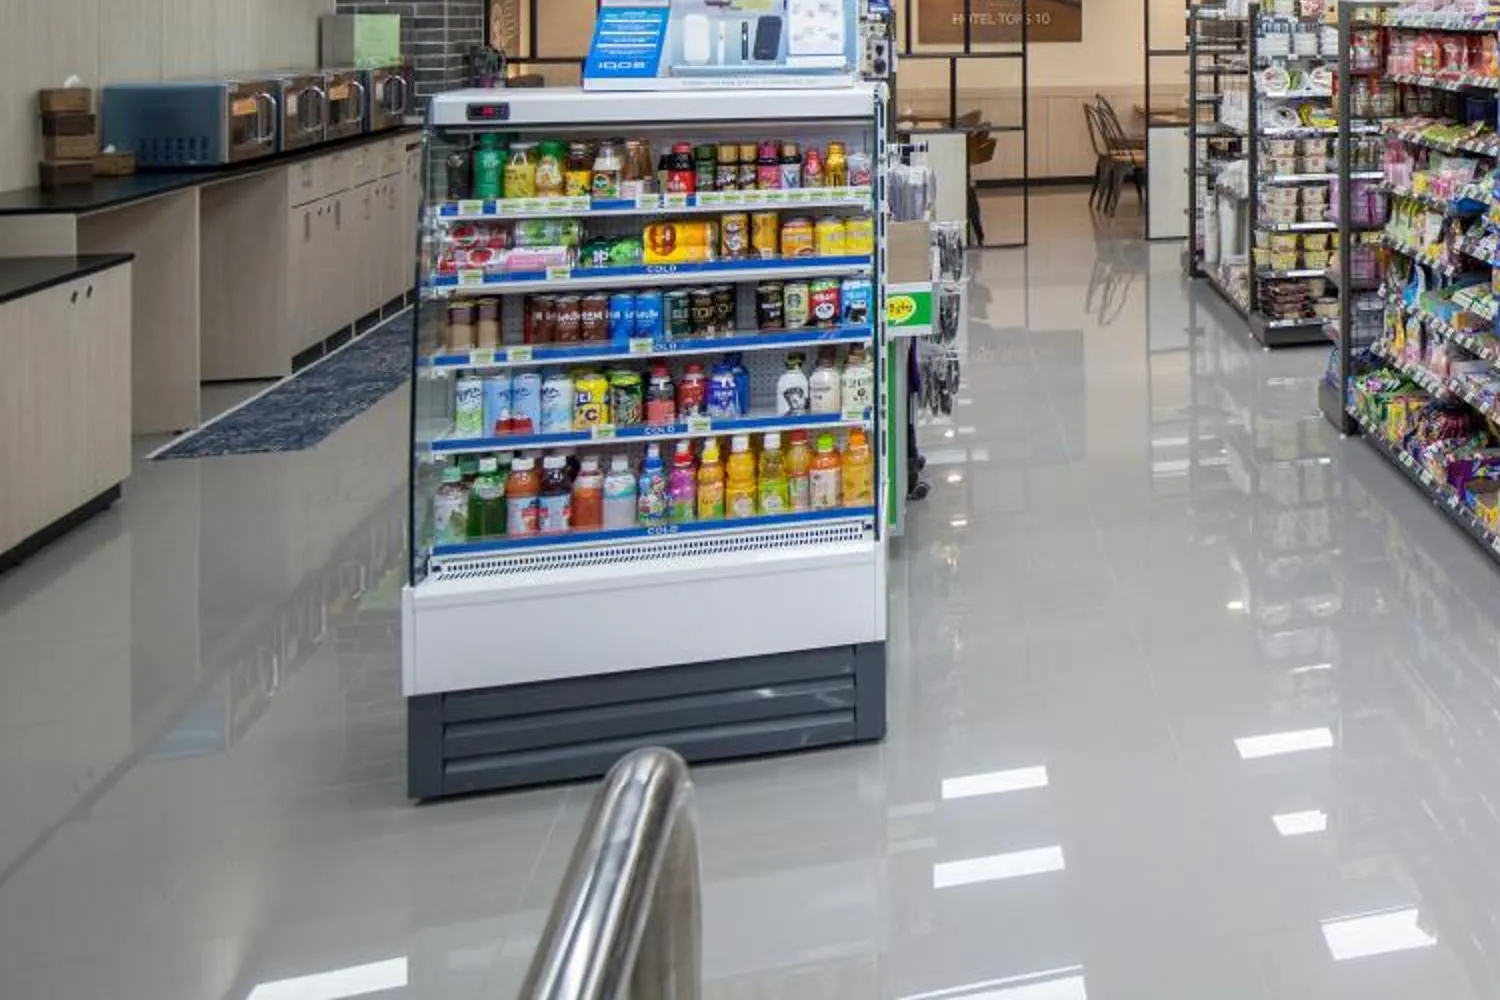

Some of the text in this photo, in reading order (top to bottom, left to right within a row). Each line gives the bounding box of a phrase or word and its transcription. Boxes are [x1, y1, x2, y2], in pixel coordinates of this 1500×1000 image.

[953, 12, 996, 25] HTEL
[1036, 12, 1051, 25] 10
[647, 264, 677, 273] COLD
[644, 425, 675, 435] COLD
[647, 525, 679, 536] COLD
